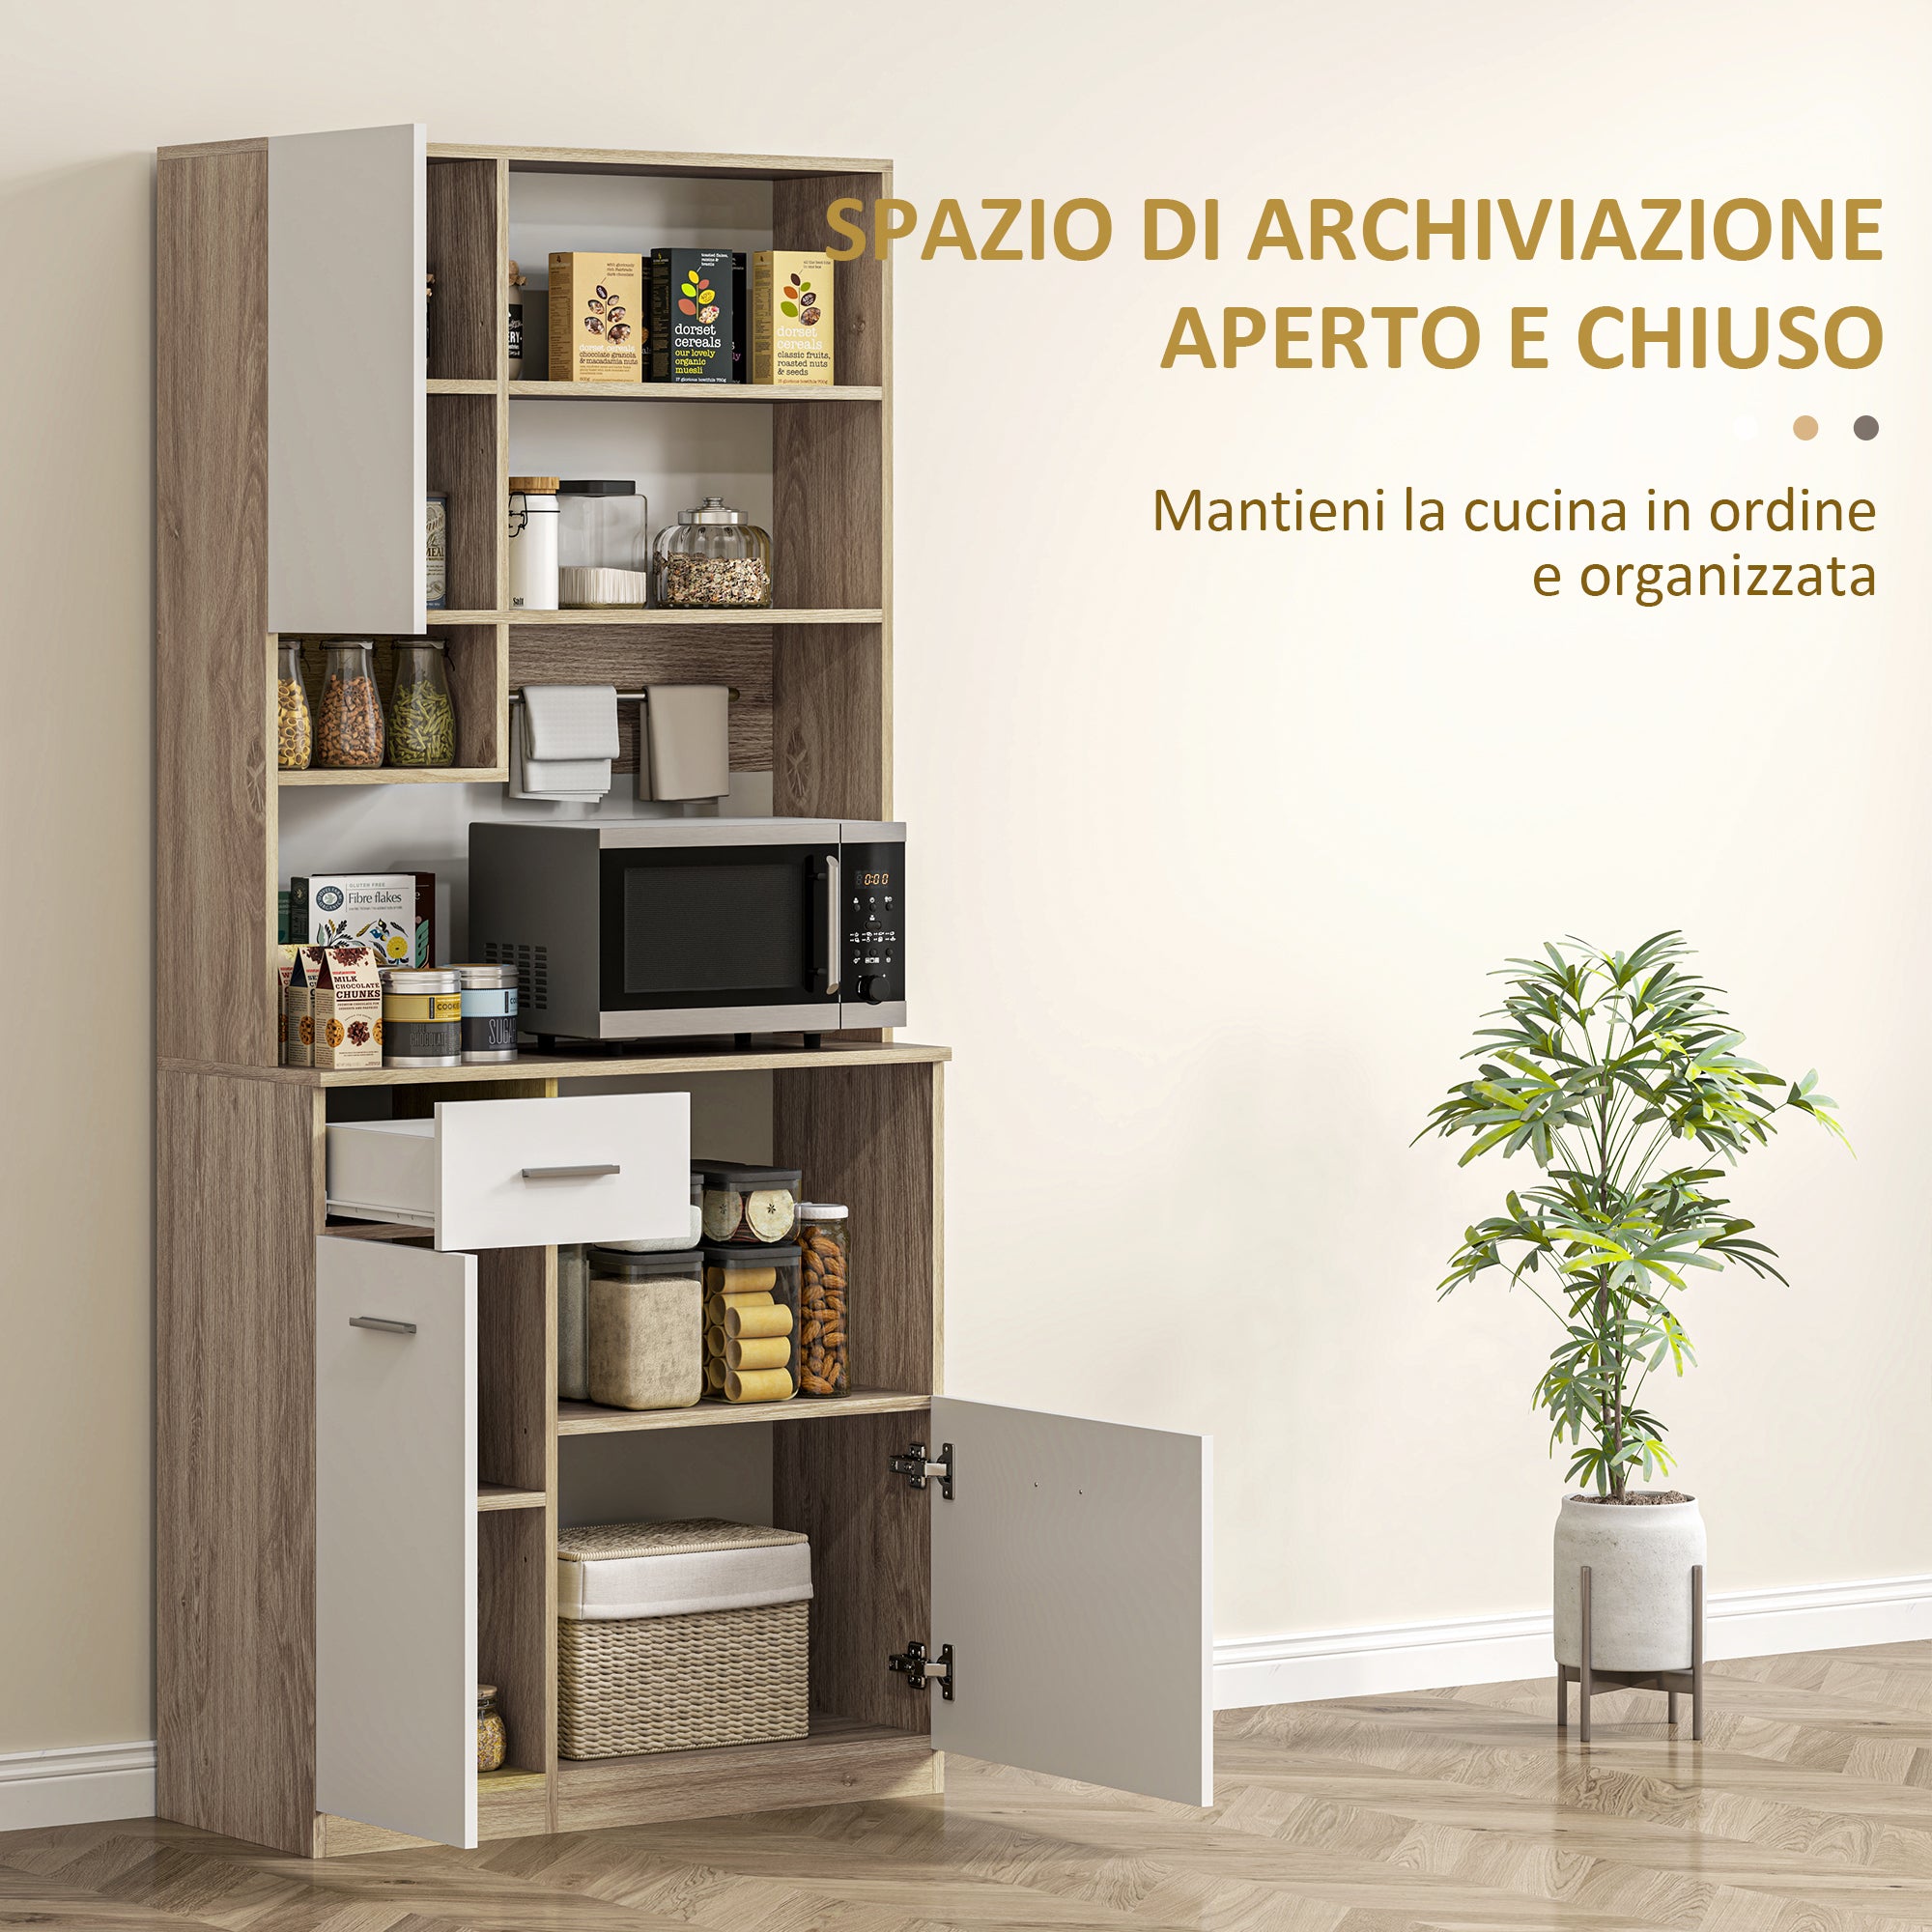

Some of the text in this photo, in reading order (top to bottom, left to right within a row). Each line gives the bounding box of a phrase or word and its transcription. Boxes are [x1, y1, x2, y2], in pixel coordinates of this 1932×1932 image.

[675, 324, 717, 335] dorset
[777, 326, 818, 338] dorset
[675, 336, 722, 348] cereals
[777, 338, 822, 351] cereals
[692, 349, 716, 359] lovely
[778, 351, 831, 360] classic fruits,
[675, 357, 706, 367] organic
[778, 359, 828, 368] roasted nuts
[675, 366, 703, 375] muesli
[349, 892, 372, 903] Fibre
[375, 891, 402, 903] flakes
[336, 990, 381, 999] CHUNKS
